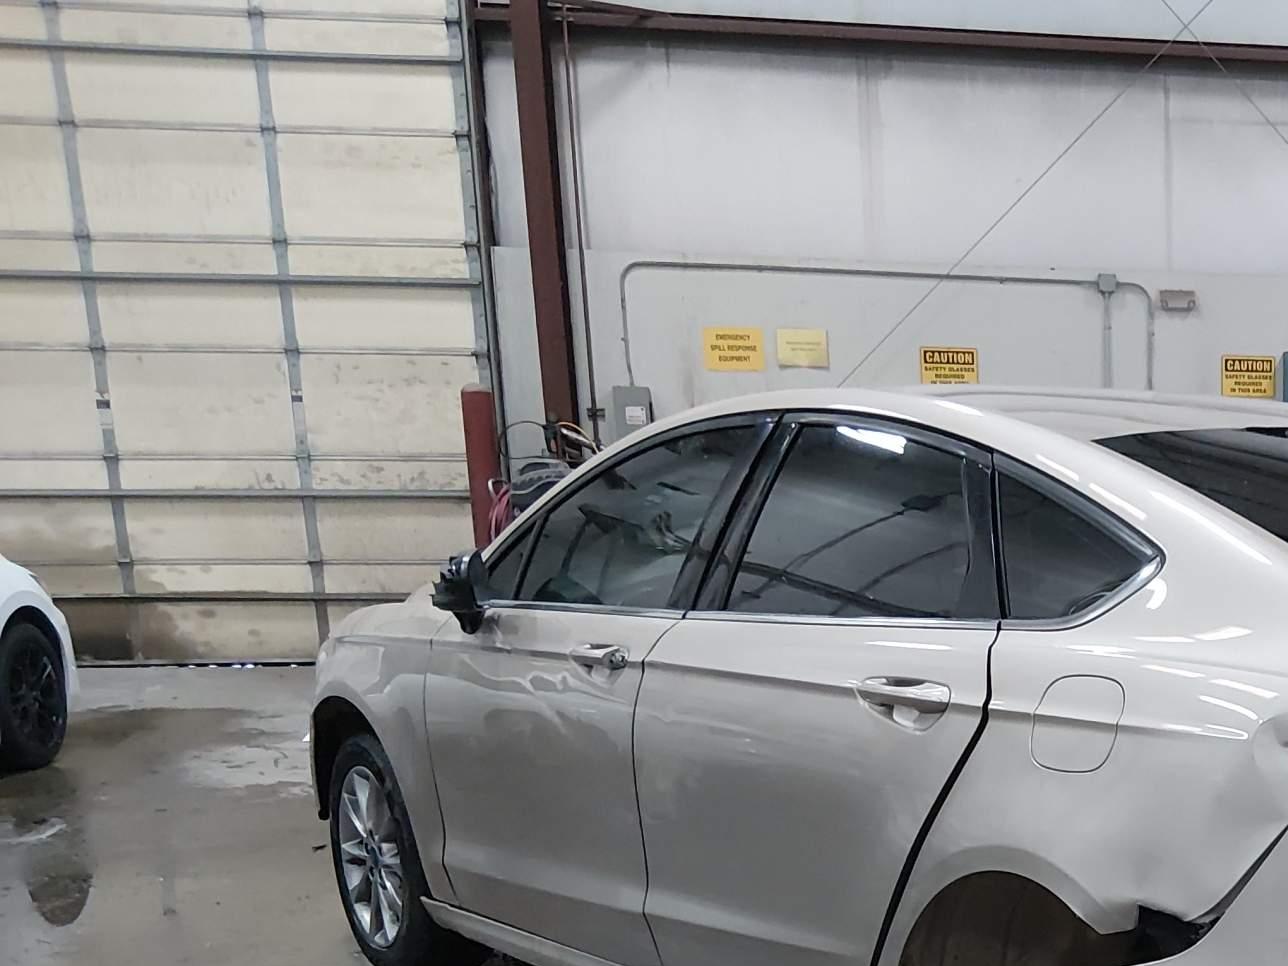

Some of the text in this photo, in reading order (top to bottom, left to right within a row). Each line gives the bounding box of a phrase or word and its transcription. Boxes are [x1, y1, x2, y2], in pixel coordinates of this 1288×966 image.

[715, 333, 750, 341] EMERGENCY
[710, 344, 757, 352] SPILL RESPONSE
[925, 351, 973, 364] CAUTION
[1226, 359, 1271, 372] CAUTION
